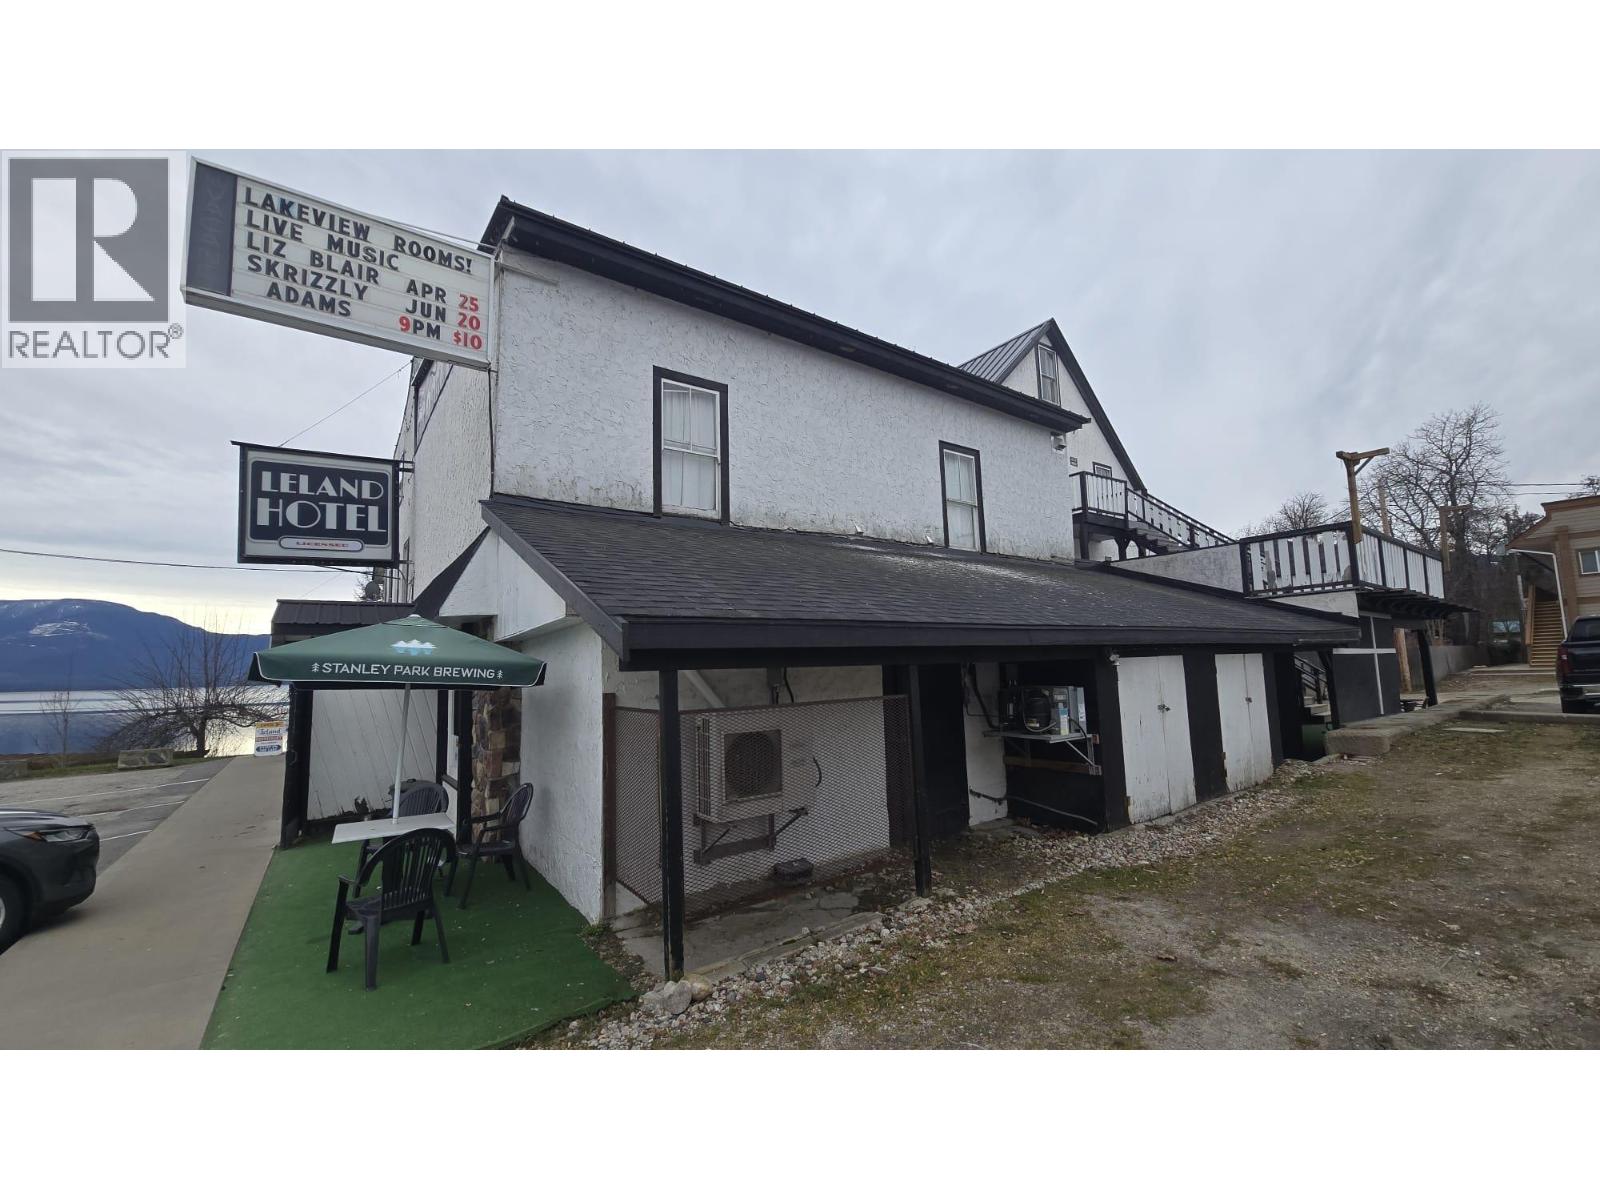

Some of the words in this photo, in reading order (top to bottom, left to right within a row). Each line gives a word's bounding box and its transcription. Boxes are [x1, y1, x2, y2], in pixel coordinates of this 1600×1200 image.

[245, 187, 370, 241] LAKEVIEW
[394, 235, 472, 274] ROOMS!
[247, 209, 303, 242] LIVE
[328, 233, 399, 271] MUSIC
[247, 231, 286, 258] LIZ
[310, 249, 379, 285] BLAIR
[406, 279, 446, 304] APR
[459, 293, 479, 312] 25
[248, 254, 368, 301] SKRIZZLY
[406, 299, 446, 323] JUN
[458, 312, 481, 331] 20
[267, 281, 351, 317] ADAMS
[399, 316, 441, 340] 9PM
[453, 330, 482, 350] $10
[256, 498, 387, 532] HOTEL
[261, 471, 384, 500] LELAND
[322, 663, 391, 675] STANLEY
[394, 665, 429, 677] PARK
[433, 667, 495, 679] BREWING
